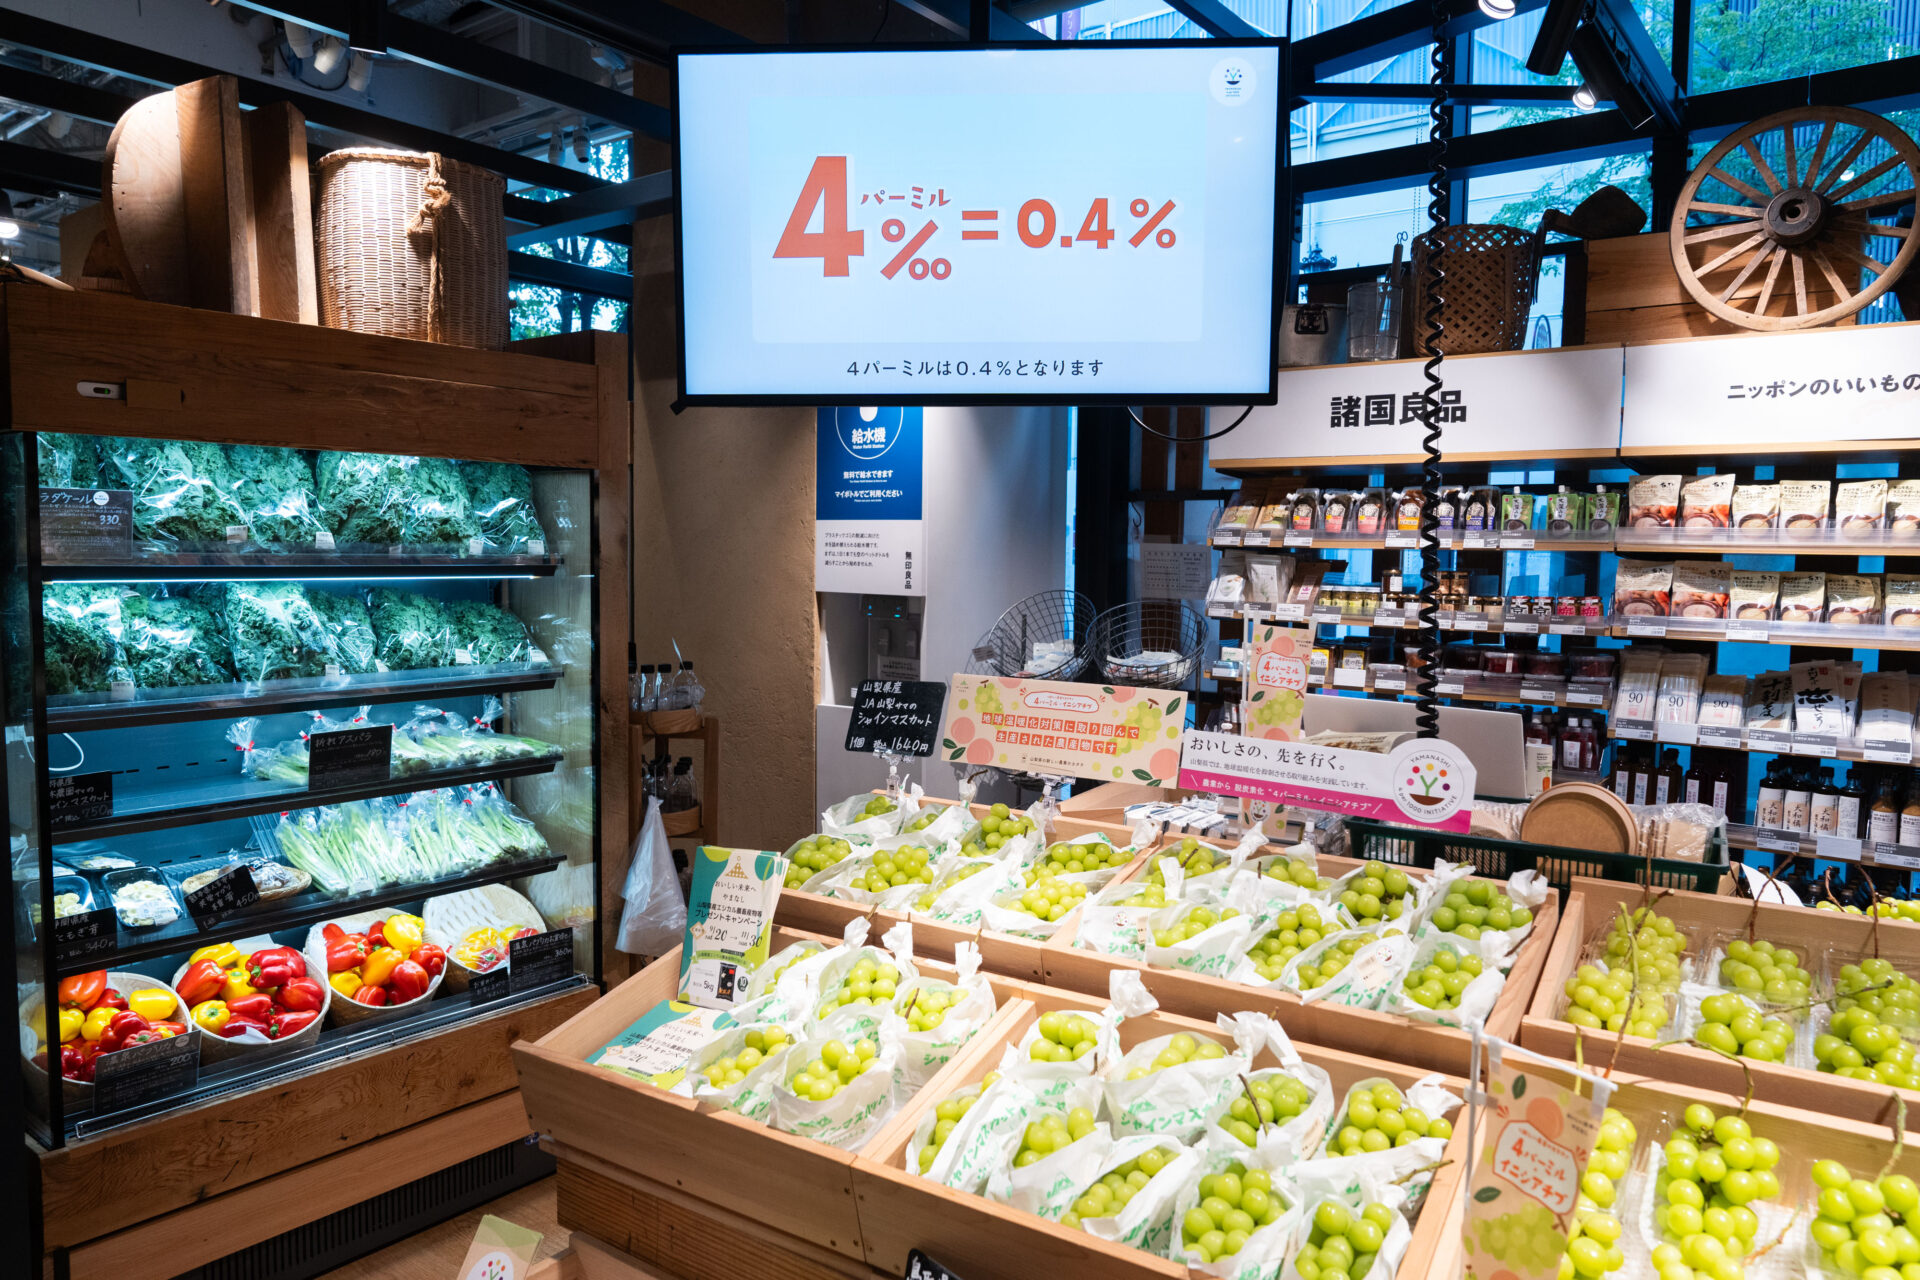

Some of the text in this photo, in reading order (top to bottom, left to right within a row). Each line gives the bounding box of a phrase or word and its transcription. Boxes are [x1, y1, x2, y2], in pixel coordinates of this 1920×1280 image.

[860, 186, 952, 210] パーミル
[846, 357, 1104, 378] 4パーミルは0.4%となります
[1330, 389, 1467, 428] 諸国良品
[851, 427, 886, 444] 給水機
[834, 489, 903, 498] マイボトルでご利用ください
[904, 551, 912, 590] 無印良品
[1628, 692, 1644, 704] 90
[1668, 695, 1684, 708] 90
[858, 711, 933, 727] シャインマスカット
[982, 711, 1140, 740] 地球温暖化対策に取り組んで
[996, 730, 1117, 755] 生産された農産物です
[1190, 736, 1346, 771] おいしさの、先を行く。
[1410, 754, 1451, 768] YAMANASHI
[1202, 778, 1231, 791] 農業から
[1234, 783, 1265, 796] 脱炭素化
[1424, 795, 1457, 815] INITIATIVE
[714, 881, 757, 892] おいしい未来へ
[722, 893, 745, 903] やまなし
[695, 909, 763, 927] プレゼントキャンペーン
[1500, 1159, 1568, 1206] イニシアチブ
